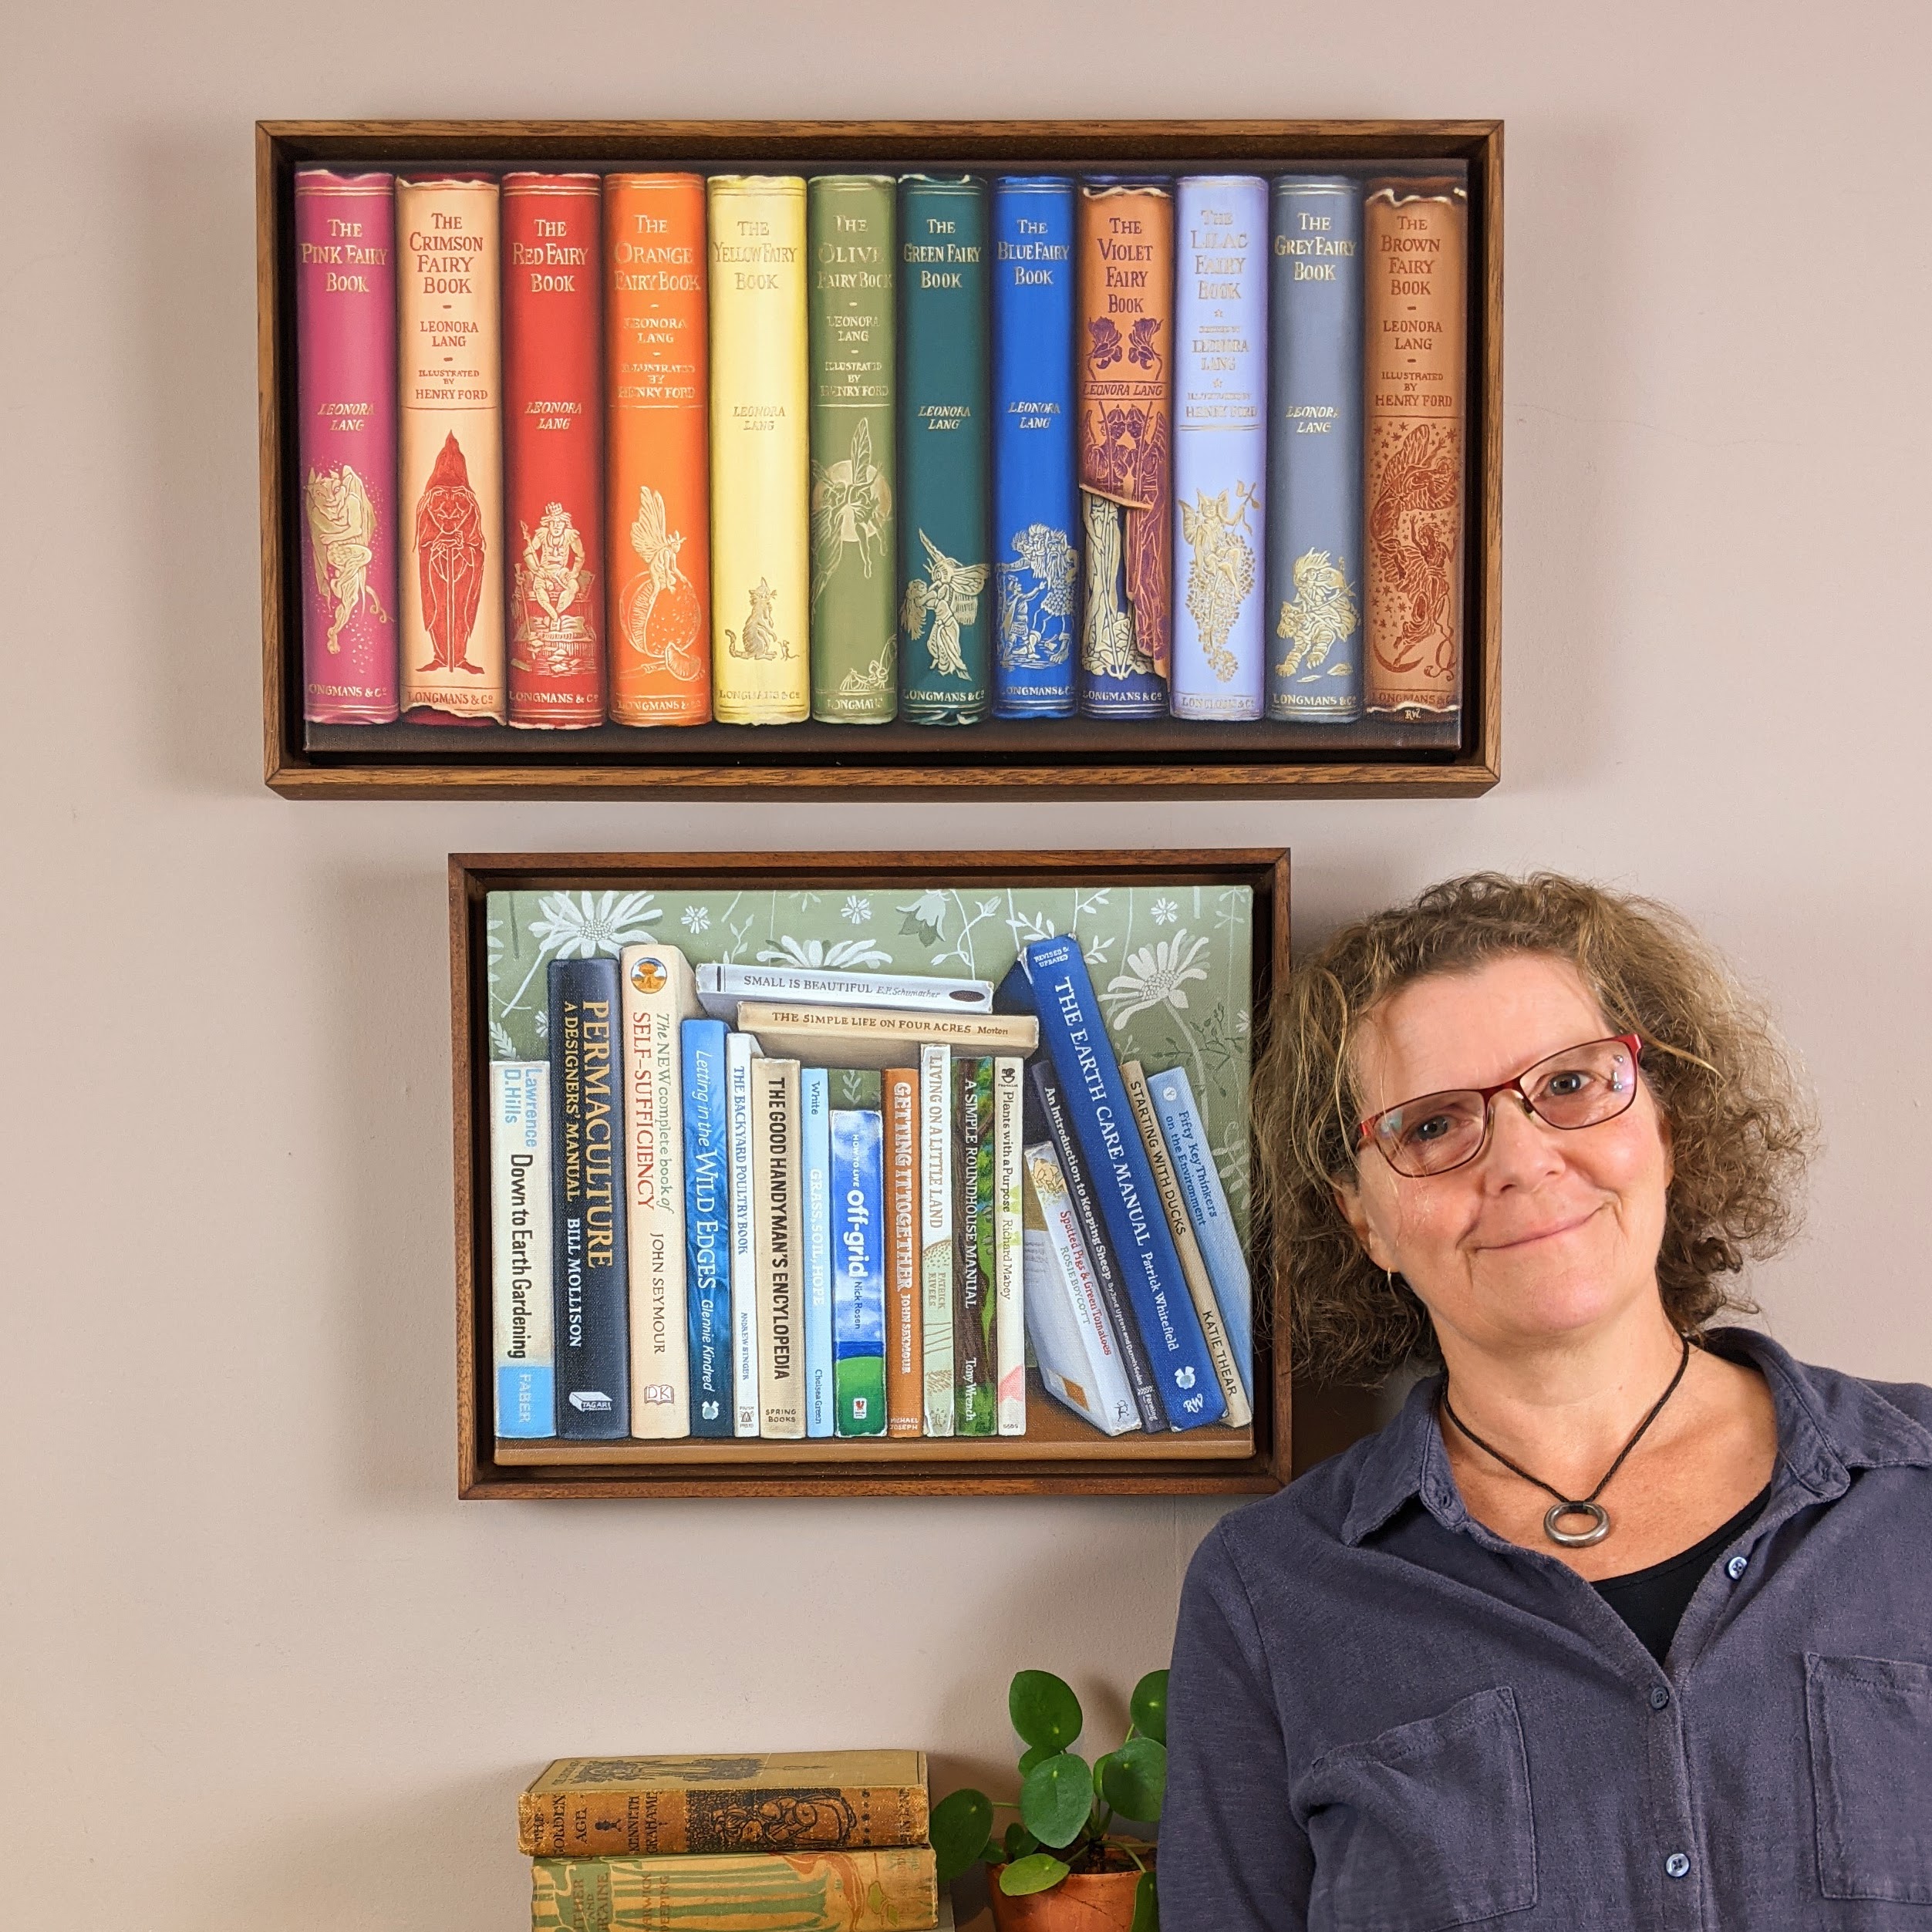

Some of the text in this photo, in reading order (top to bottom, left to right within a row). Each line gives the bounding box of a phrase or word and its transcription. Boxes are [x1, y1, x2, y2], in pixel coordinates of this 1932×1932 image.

[327, 219, 362, 237] THE
[431, 213, 462, 229] THE
[534, 220, 566, 237] THE
[634, 214, 667, 233] THE
[927, 219, 956, 234] THE
[1017, 219, 1047, 234] THE
[1109, 217, 1142, 234] THE
[1297, 213, 1331, 230] THE
[1398, 216, 1428, 230] THE
[410, 232, 483, 251] CRIMSON
[997, 242, 1033, 261] BLUE
[1097, 238, 1153, 261] VIOLET
[1275, 236, 1313, 256] GREY
[1381, 235, 1440, 252] BROWN
[302, 244, 342, 264] PINK
[417, 255, 474, 272] FAIRY
[513, 243, 588, 265] RED FAIRY
[904, 244, 981, 263] GREEN FAIRY
[1014, 267, 1054, 285] BOOK
[1294, 262, 1336, 281] BOOK
[1388, 257, 1435, 274] FAIRY
[325, 273, 369, 292] BOOK
[423, 278, 472, 294] BOOK
[531, 274, 575, 292] BOOK
[921, 271, 963, 288] BOOK
[1105, 267, 1148, 288] FAIRY
[1391, 279, 1431, 295] BOOK
[1108, 295, 1144, 313] BOOK
[420, 321, 479, 332] LEONORA
[1383, 321, 1442, 332] LEONORA
[432, 335, 467, 347] LANG
[1394, 338, 1432, 349] LANG
[1382, 372, 1444, 381] ILLUSTRATED
[416, 389, 487, 400] HENRY FORD
[1375, 395, 1452, 407] HENRY FORD
[537, 418, 570, 430] LANG
[929, 419, 960, 430] LANG
[407, 691, 469, 704] LONGMANS
[509, 690, 573, 703] LONGMANS
[903, 690, 966, 702] LONGMANS
[1083, 690, 1141, 701] LONGMANS
[1273, 694, 1337, 706] LONGMANS
[744, 976, 872, 993] SMALL IS BEAUTIFUL
[772, 1012, 1008, 1036] THE SIMPLE LIFE ON FOUR ACRES Morton
[524, 1068, 542, 1148] Lawrence
[564, 1001, 581, 1202] A MANUAL
[811, 1081, 820, 1114] White
[632, 1012, 655, 1210] SELF-SUFFICIENCY
[655, 1013, 674, 1214] The NEW complete book of
[1002, 1091, 1014, 1128] Plants
[1054, 976, 1150, 1247] THE EARTH CARE MANUAL
[583, 1000, 612, 1269] PERMACULTURE
[894, 1082, 912, 1168] GETTING
[929, 1055, 943, 1228] LIVING ON LITTLE LAND
[1003, 1131, 1013, 1155] with
[734, 1067, 748, 1255] THE BACKYARD POULTRY BOOK
[1130, 1081, 1186, 1235] STARTING WITH DUCKS
[1178, 1110, 1218, 1218] Fifty Key Thinkers
[692, 1050, 719, 1290] Letting in the WILD EDGES
[768, 1077, 788, 1269] THE GOOD HANDYMAN'S
[1165, 1115, 1206, 1226] on the Environment
[1000, 1167, 1013, 1212] Purpose
[1045, 1087, 1111, 1280] An Introduction Keeping Sheep
[964, 1094, 978, 1309] SIMPLE ROUNDHOUSE MANUAL
[843, 1189, 869, 1278] Off-grid
[1003, 1219, 1013, 1261] Richard
[508, 1155, 533, 1359] Down to Earth Gardening
[1060, 1246, 1076, 1280] ROSIE
[568, 1219, 582, 1347] BILL MOLLISON
[650, 1232, 665, 1354] JOHN SEYMOUR
[928, 1273, 937, 1307] RIVERS
[938, 1273, 946, 1309] PATRICK
[1060, 1210, 1112, 1356] Spotted Pigs Green Tomatoes
[854, 1281, 862, 1330] Nick Rosen
[1141, 1251, 1180, 1352] Patrick Whitefield
[900, 1294, 911, 1374] JOHN SEYMOUR
[701, 1299, 715, 1392] Glennie Kindred
[1202, 1310, 1238, 1396] KATIE THEAR
[647, 1387, 670, 1399] DK
[963, 1357, 977, 1421] Tony Wrench
[534, 1813, 545, 1843] THE
[552, 1794, 567, 1856] GOLDEN
[575, 1807, 588, 1844] AGE
[628, 1795, 640, 1852] KENNETH
[646, 1792, 659, 1854] GRAHAME
